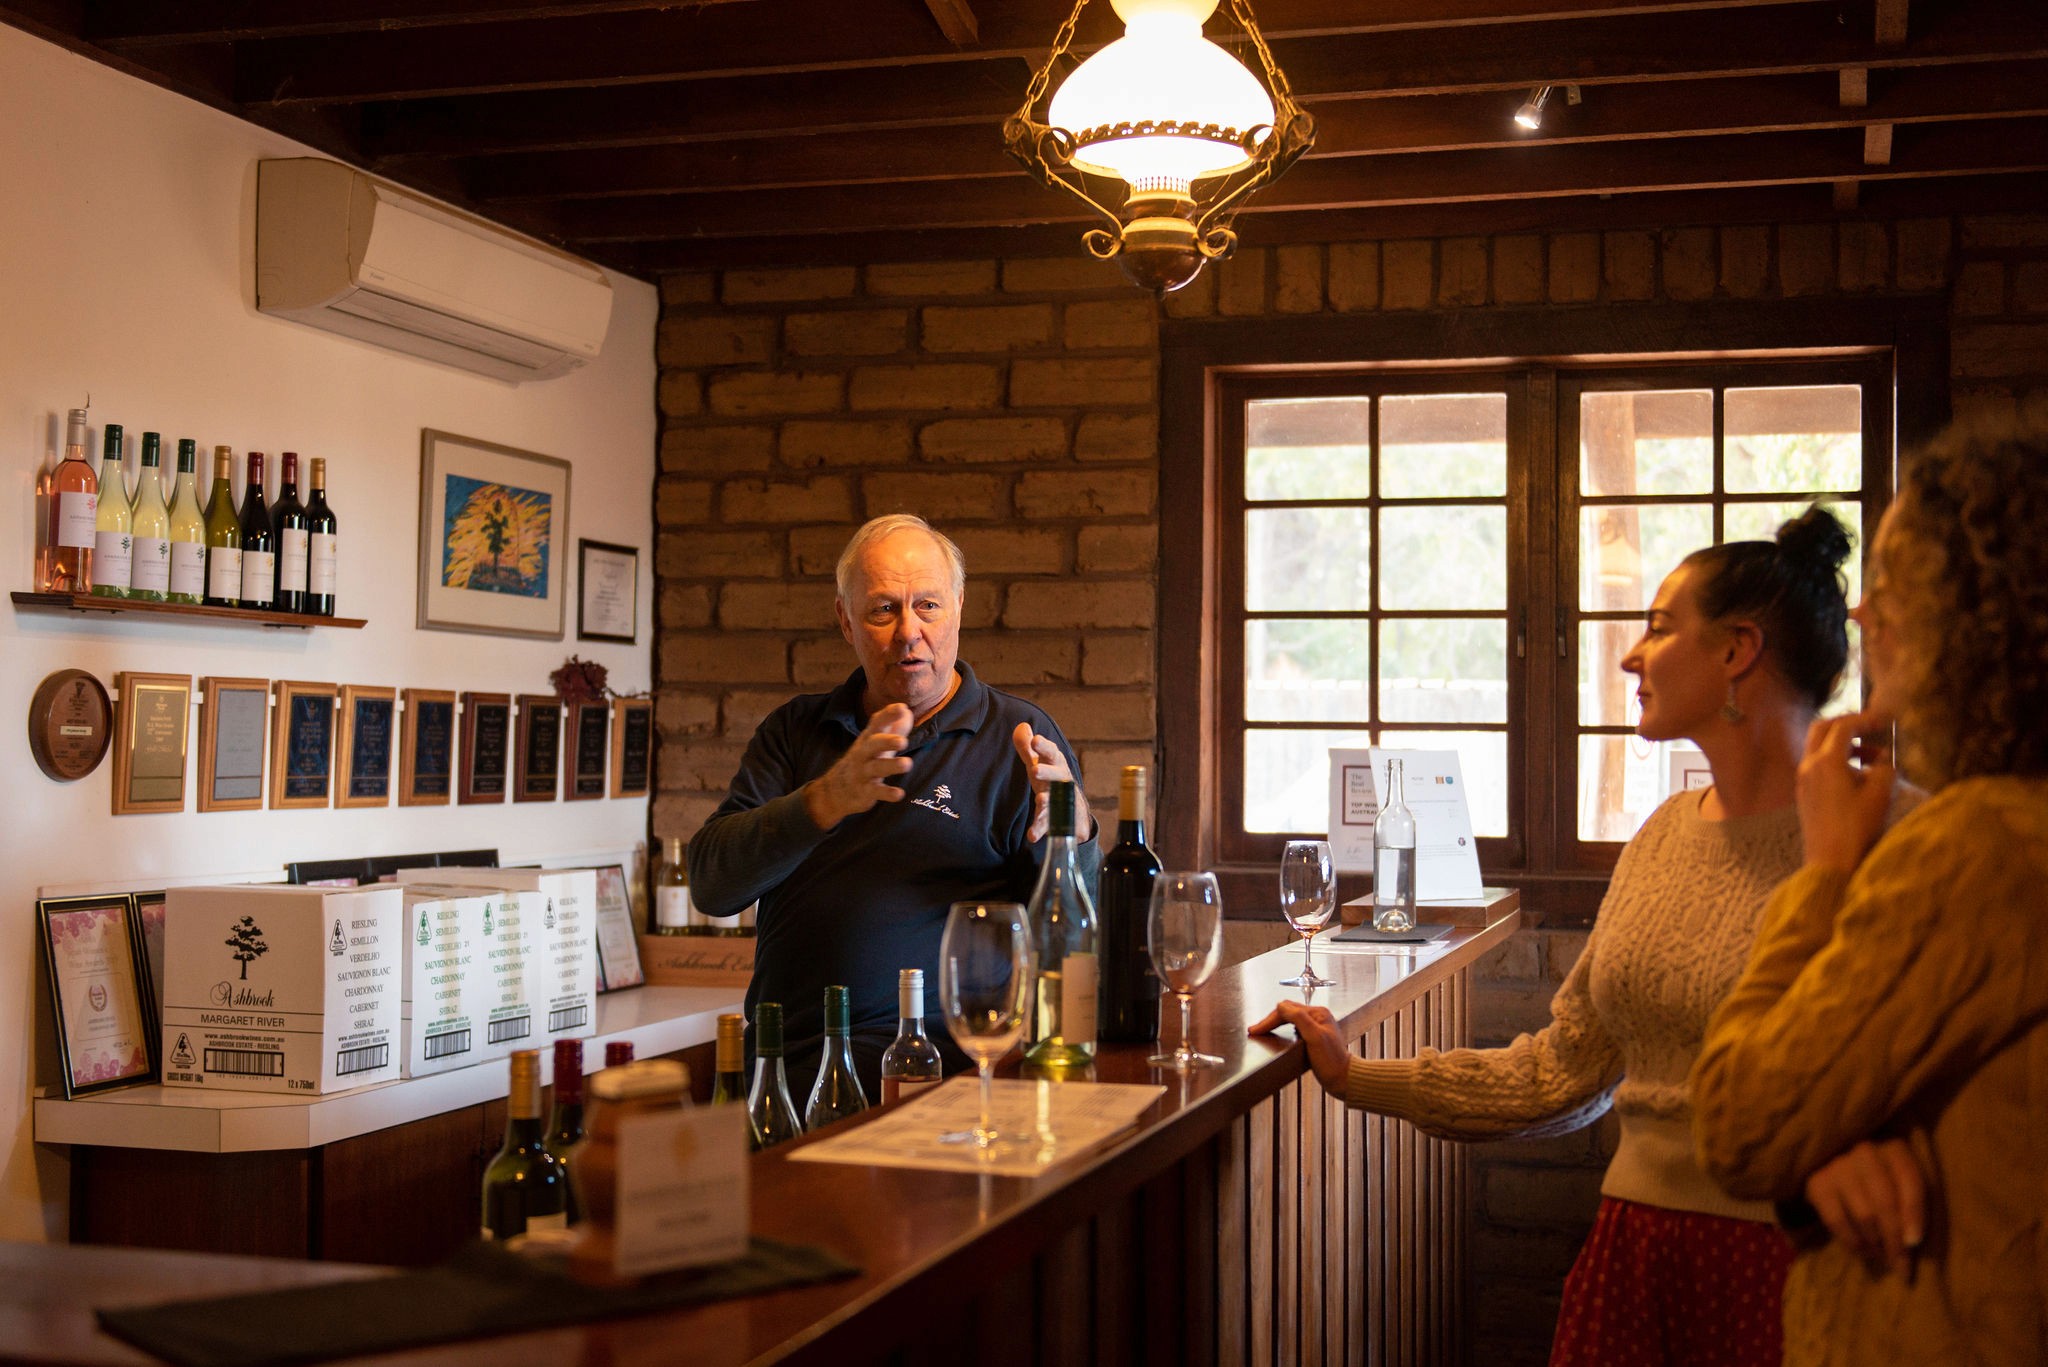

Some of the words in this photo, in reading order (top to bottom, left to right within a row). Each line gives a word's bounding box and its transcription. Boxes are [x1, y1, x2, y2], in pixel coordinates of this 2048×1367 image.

[437, 911, 459, 920] RIESLING
[351, 918, 378, 929] RIESLING
[436, 926, 460, 937] SEMILLON
[350, 935, 379, 946] SEMILLON
[435, 942, 461, 952] VERDELHO
[349, 951, 380, 963] VERDELHO
[424, 959, 454, 970] SAUVIGNON
[454, 955, 471, 966] BLANC
[493, 961, 525, 974] CHARDONNAY
[337, 971, 371, 982] SAUVIGNON
[371, 966, 391, 977] BLANC
[431, 972, 465, 985] CHARDONNAY
[498, 977, 522, 988] CABERNET
[209, 980, 275, 1008] Ashbrook
[344, 983, 384, 998] CHARDONNAY
[435, 989, 461, 1001] CABERNET
[349, 1001, 379, 1013] CABERNET
[439, 1005, 457, 1016] SHIRAZ
[200, 1013, 254, 1026] MARGARET
[257, 1017, 285, 1027] RIVER
[354, 1018, 375, 1029] SHIRAZ
[204, 1033, 285, 1043] www.ashbrookwines.com.au
[208, 1040, 235, 1048] ASHBROOK
[235, 1041, 253, 1049] ESTATE
[180, 1072, 194, 1082] WEIGHT
[288, 1079, 295, 1088] 12
[299, 1080, 315, 1090] 750ml
